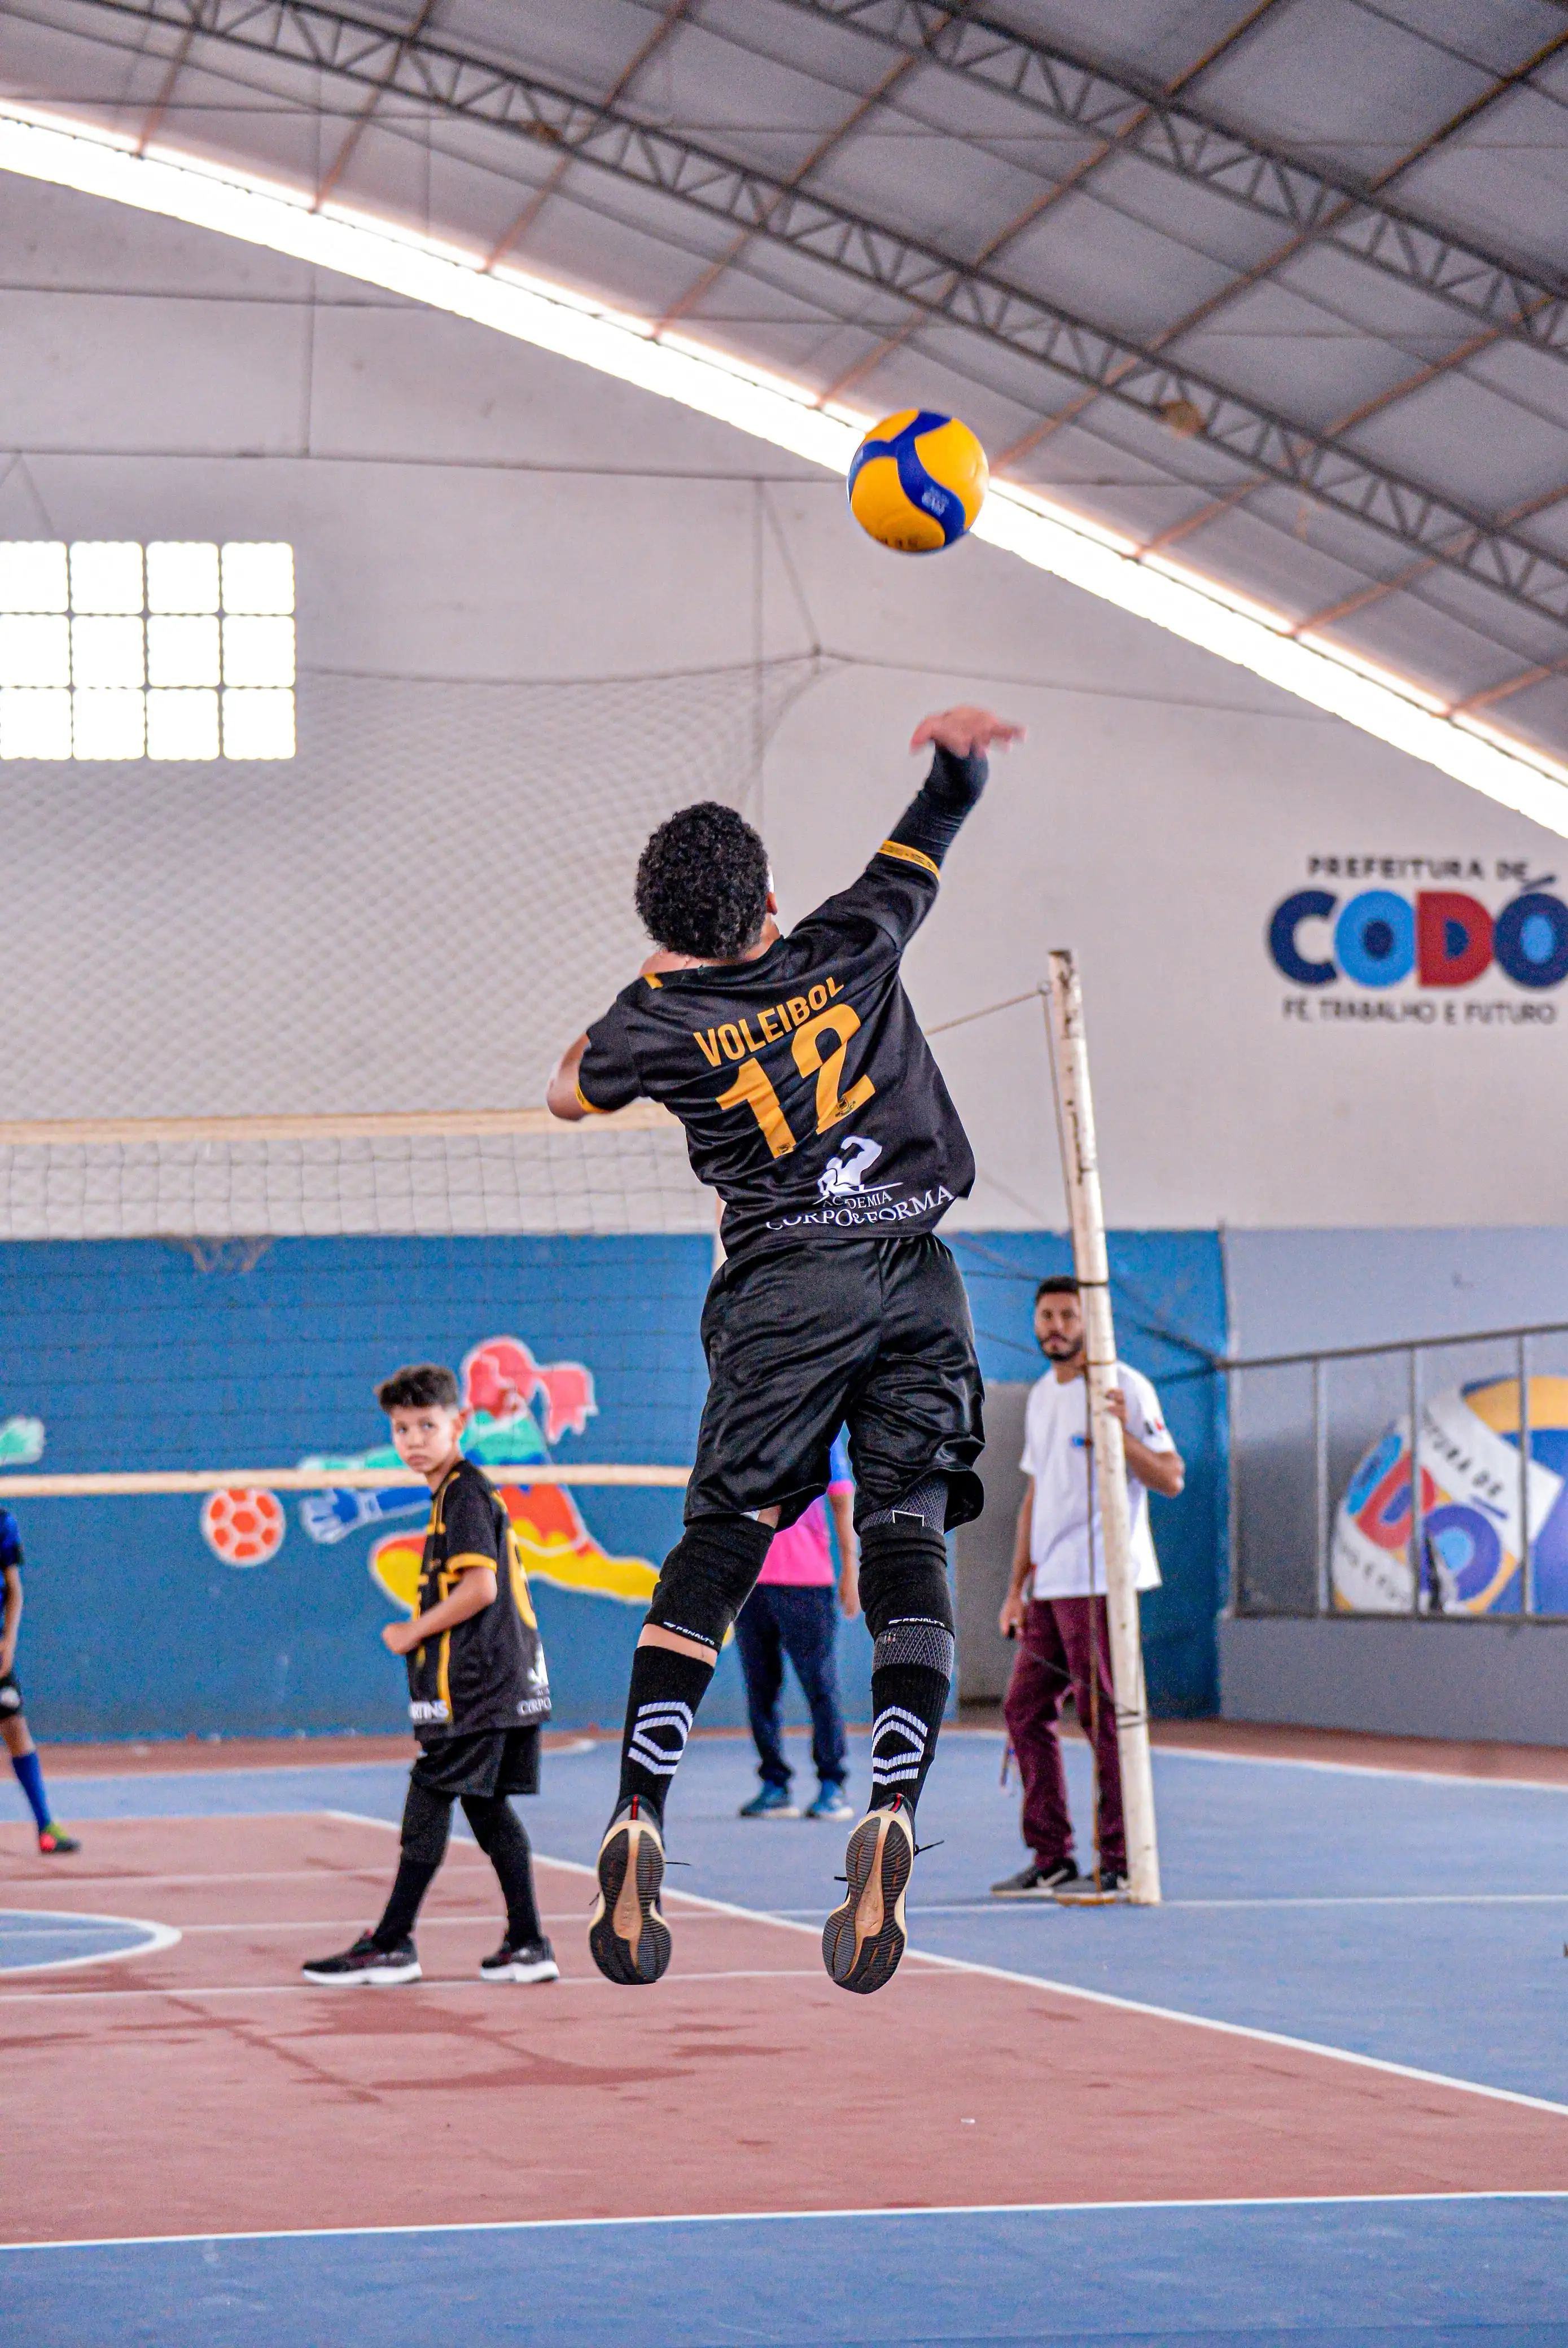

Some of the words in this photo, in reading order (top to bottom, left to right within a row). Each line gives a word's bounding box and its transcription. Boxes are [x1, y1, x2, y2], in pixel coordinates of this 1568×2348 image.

[1306, 855, 1484, 879] PREFEITURA
[1495, 858, 1529, 882] DE
[1268, 874, 1568, 991] CODÓ
[693, 977, 844, 1067] VOLEIBOL
[1319, 998, 1437, 1025] TRABALHO
[1444, 1001, 1458, 1026] E
[1465, 1001, 1557, 1026] FUTURO
[715, 1003, 877, 1159] 12
[822, 1190, 893, 1210] ACDEMIA
[901, 1617, 945, 1628] PENALTY
